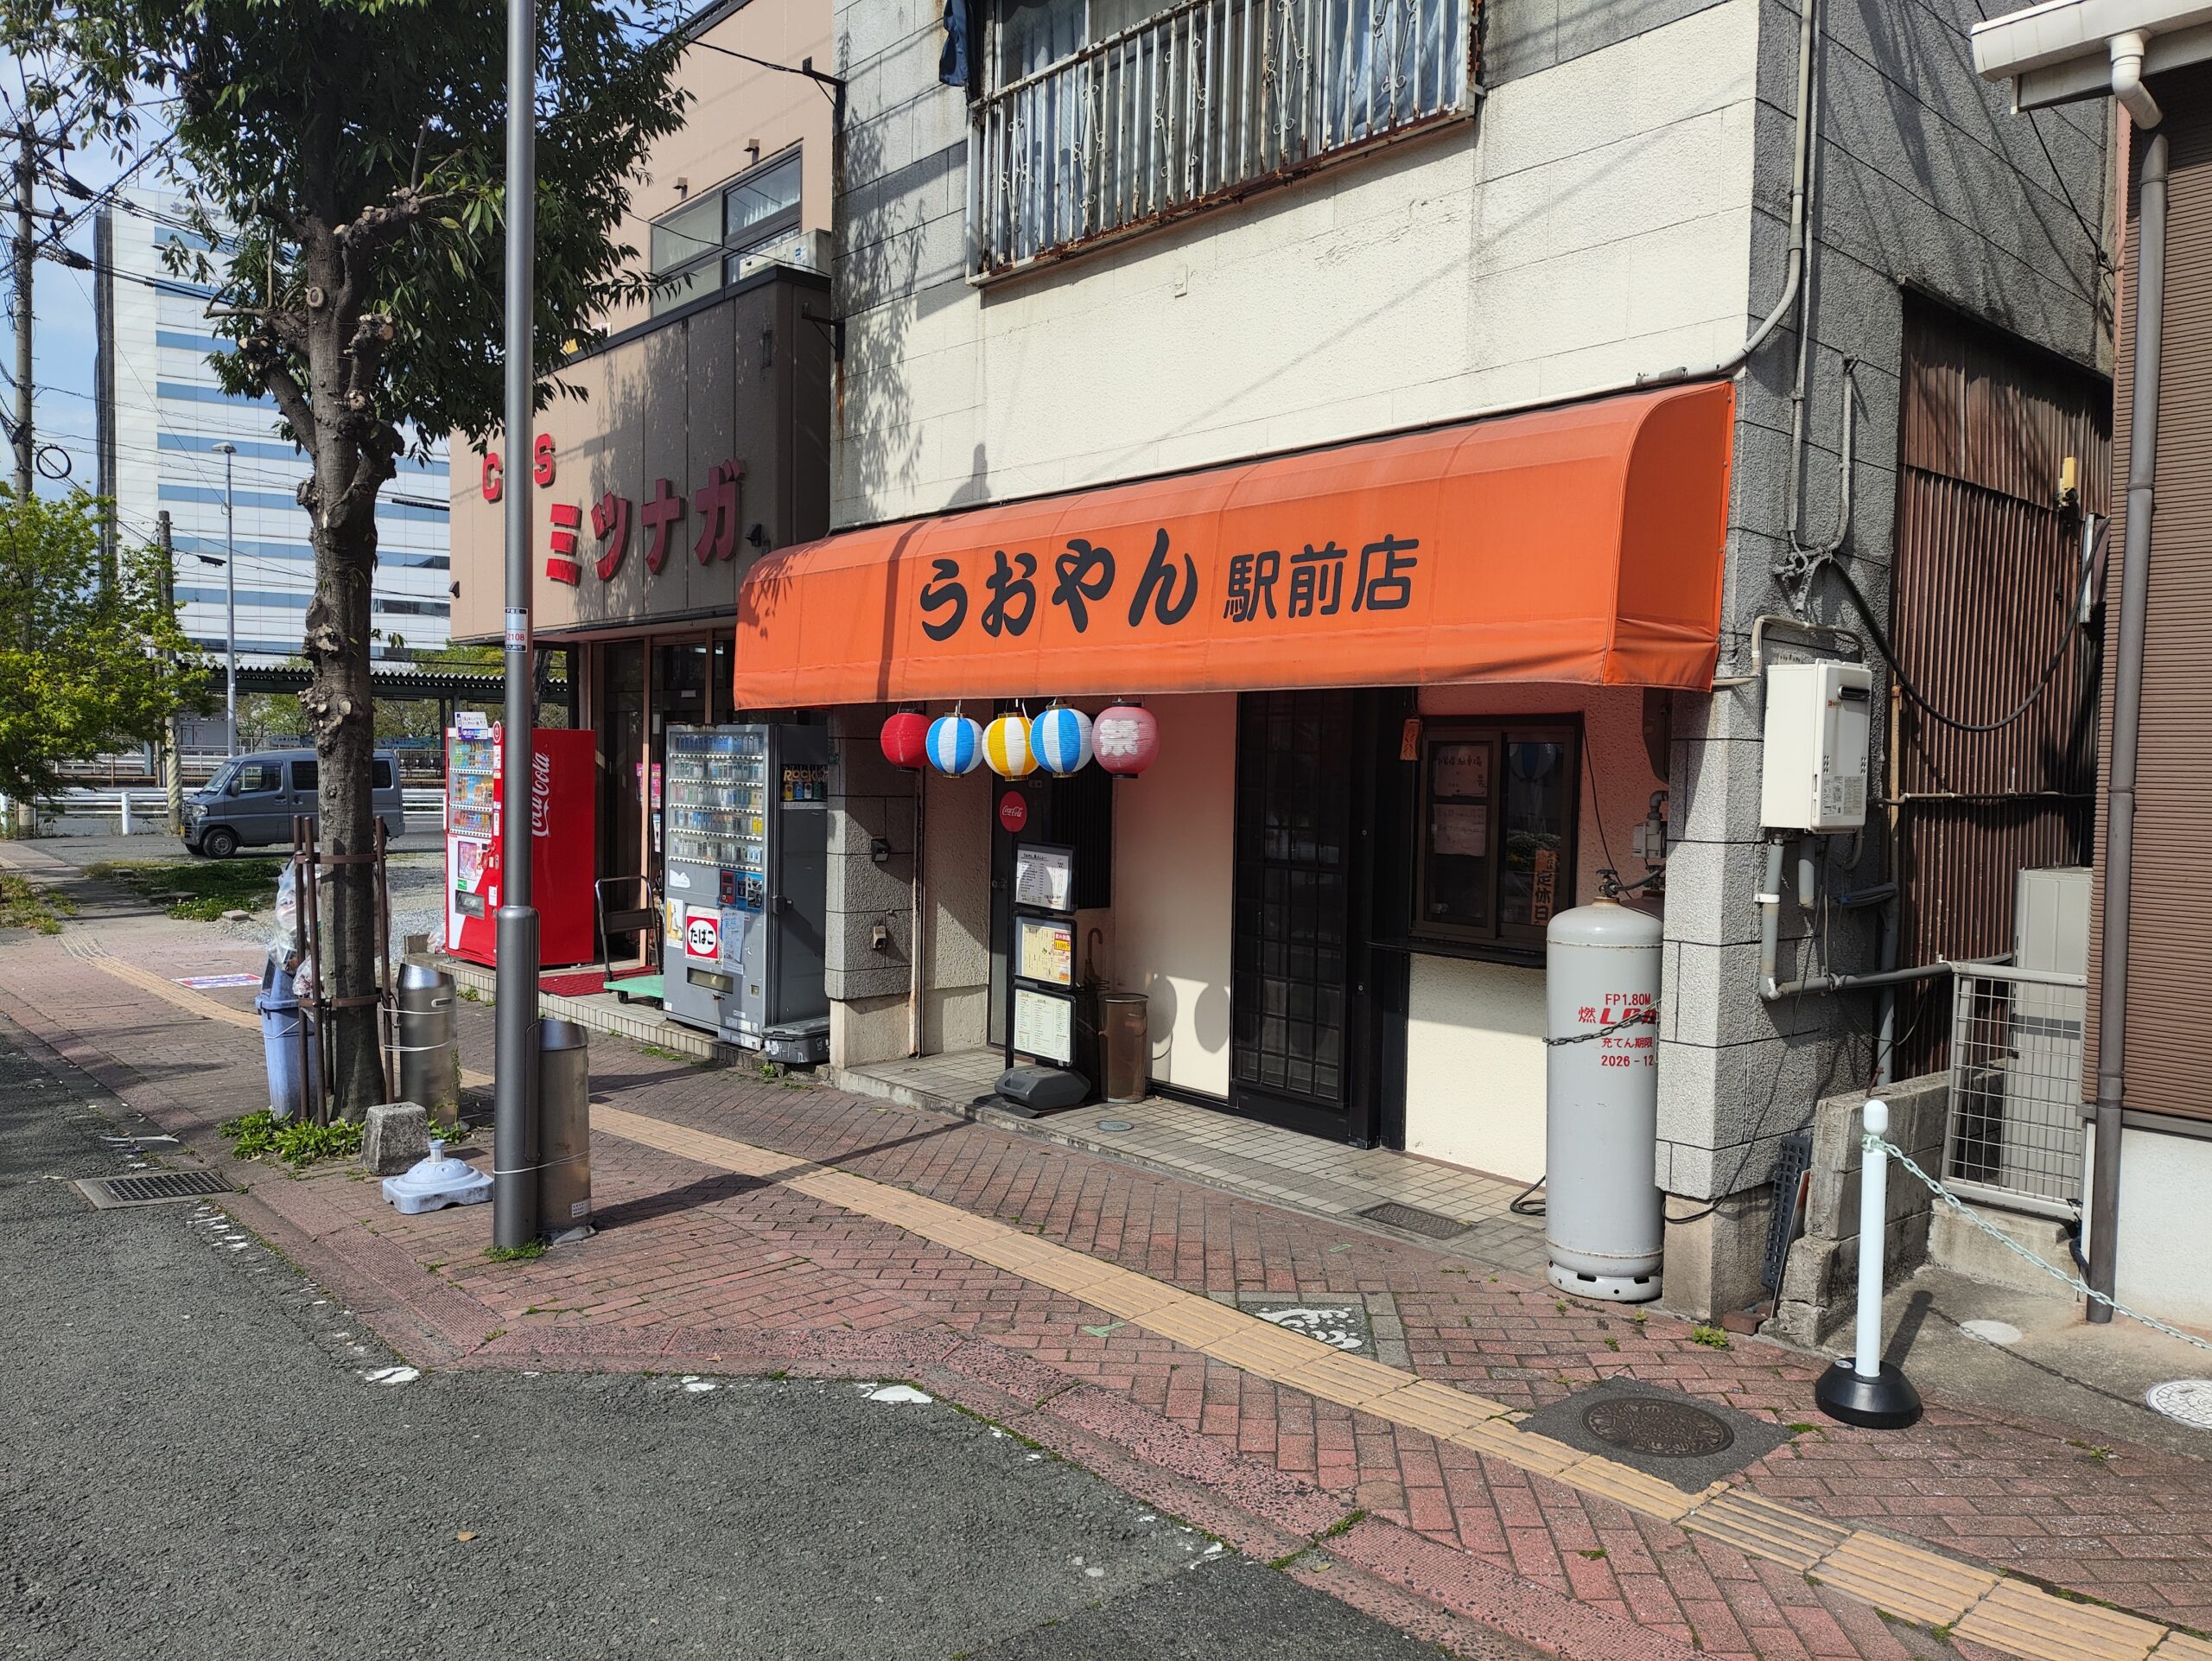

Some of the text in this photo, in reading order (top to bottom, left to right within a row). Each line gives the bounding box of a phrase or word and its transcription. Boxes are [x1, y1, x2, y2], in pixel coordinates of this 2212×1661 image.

[546, 458, 746, 587] ミツナガ
[919, 528, 1421, 642] うおやん 駅前店
[1535, 869, 1553, 921] 定休日
[690, 927, 715, 945] たばこ
[1605, 993, 1651, 1006] FP1.80M
[1578, 1006, 1596, 1024] 燃
[1601, 1037, 1653, 1048] 充てん期限
